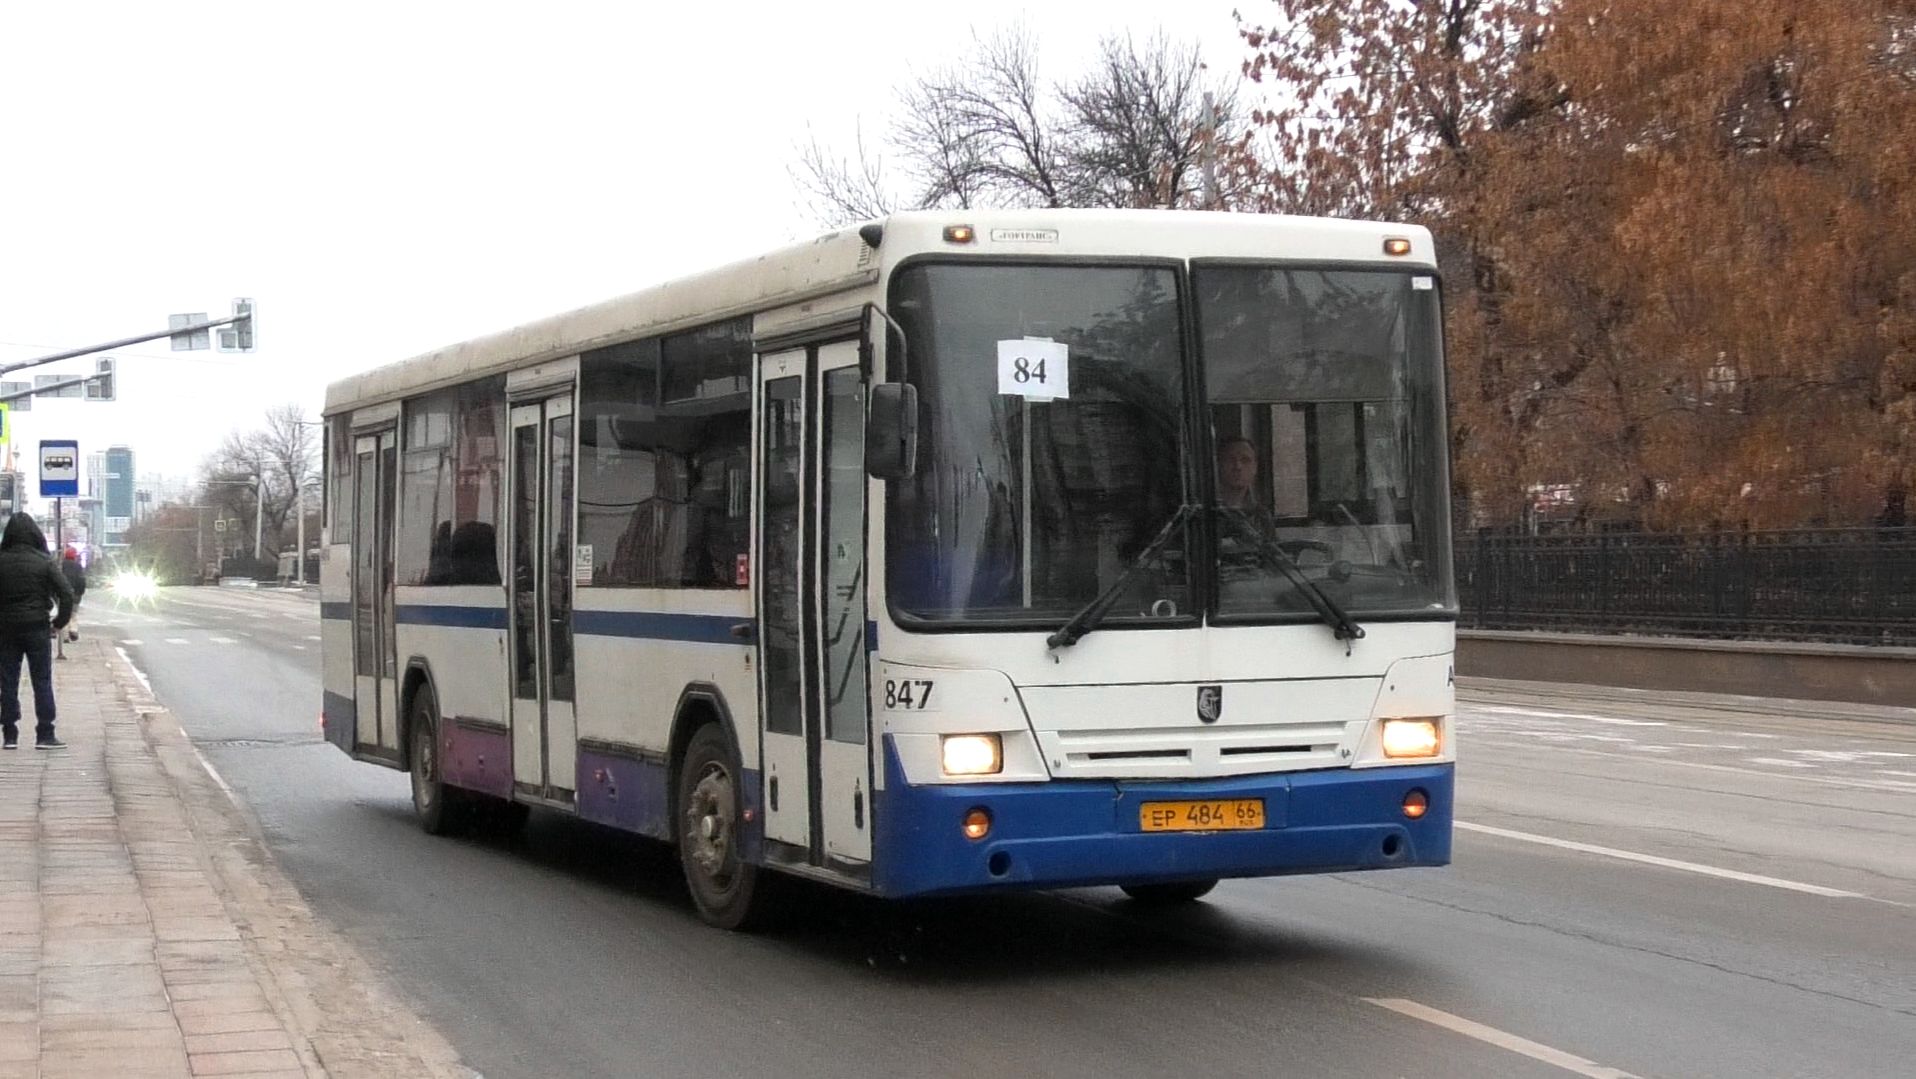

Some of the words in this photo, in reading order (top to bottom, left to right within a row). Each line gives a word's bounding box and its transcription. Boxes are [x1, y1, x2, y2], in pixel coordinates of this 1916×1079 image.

[1014, 357, 1047, 384] 84
[886, 680, 933, 709] 847
[1187, 804, 1224, 826] 484
[1236, 802, 1256, 819] 66
